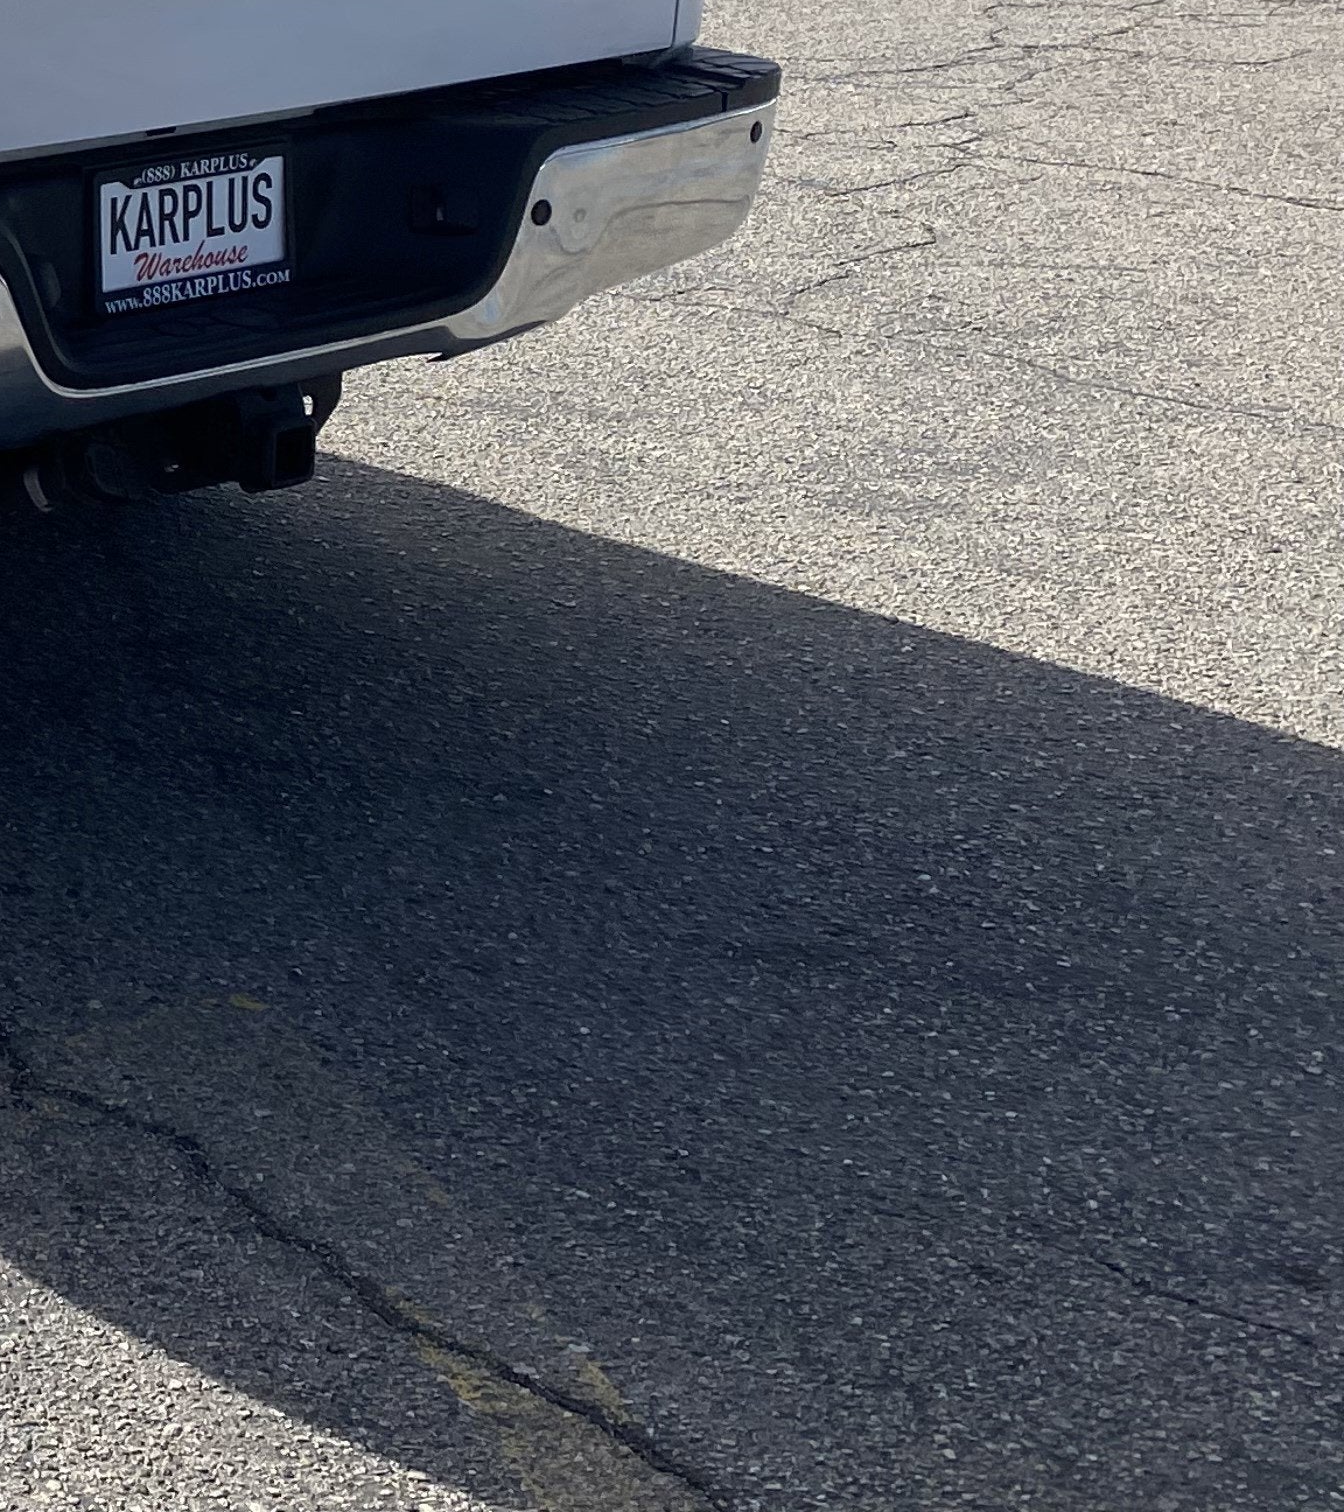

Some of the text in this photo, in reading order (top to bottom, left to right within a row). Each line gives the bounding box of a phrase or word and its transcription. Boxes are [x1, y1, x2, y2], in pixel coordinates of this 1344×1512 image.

[180, 152, 249, 178] KARPLUS
[109, 172, 273, 256] KARPLUS
[133, 239, 249, 282] Warehouse
